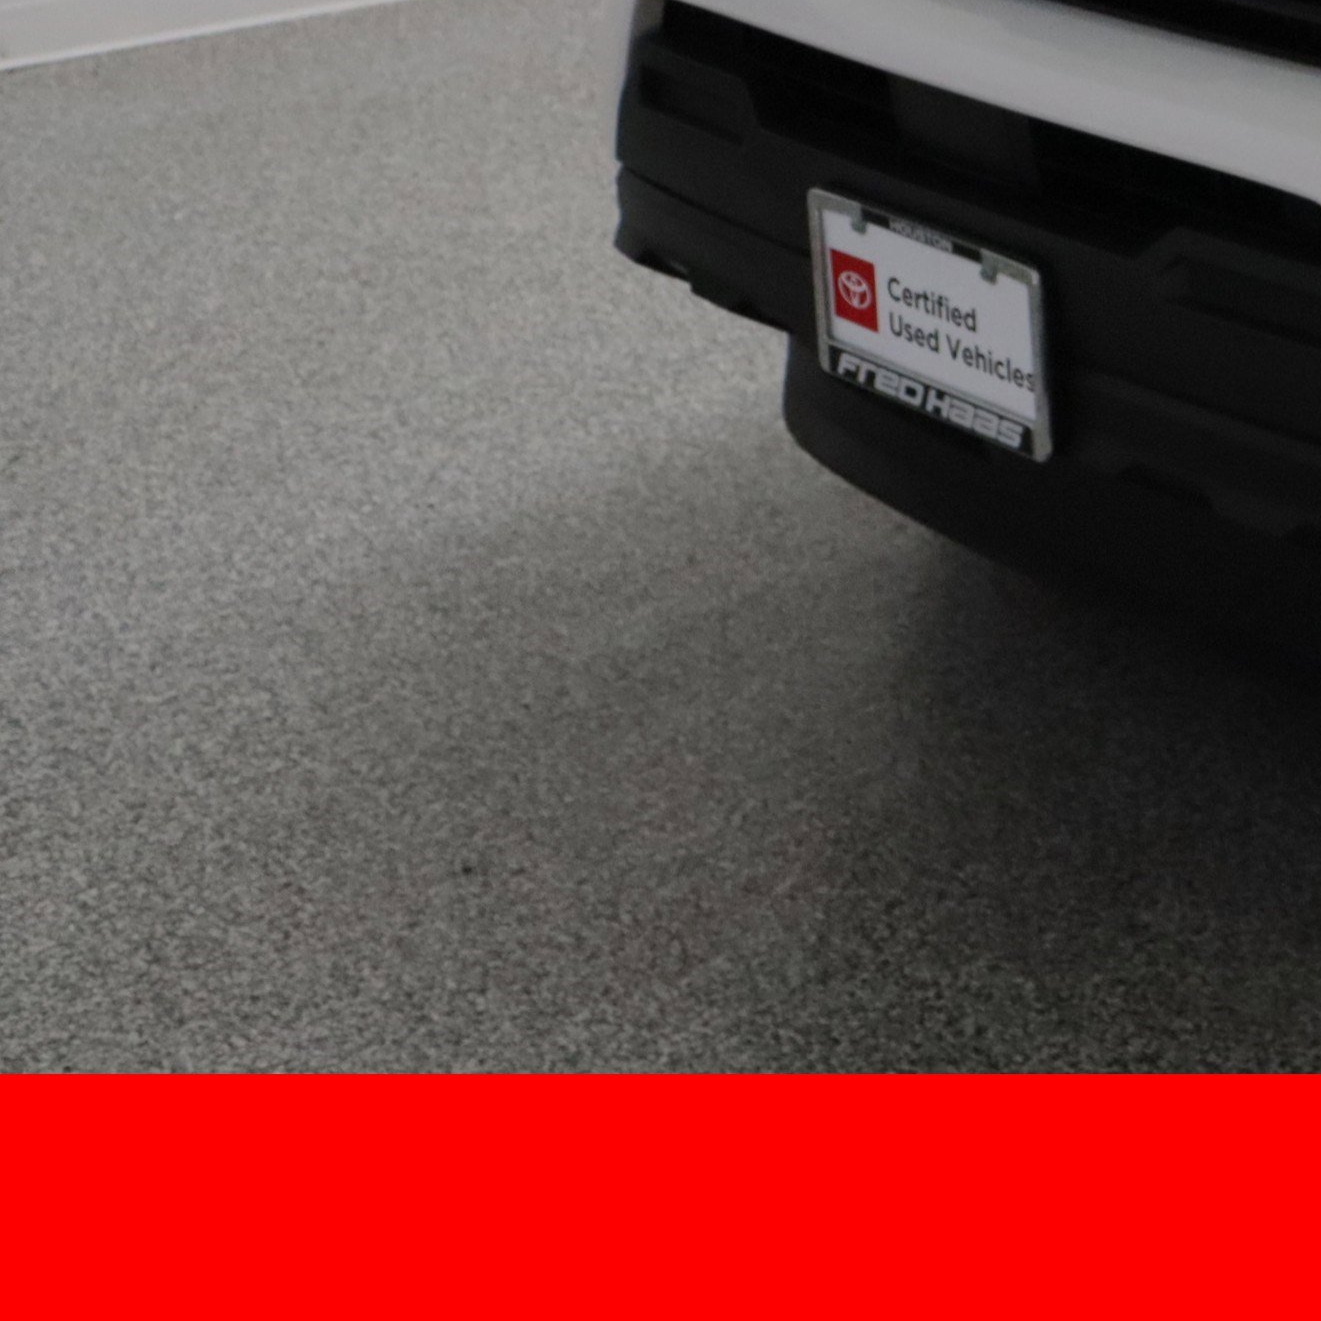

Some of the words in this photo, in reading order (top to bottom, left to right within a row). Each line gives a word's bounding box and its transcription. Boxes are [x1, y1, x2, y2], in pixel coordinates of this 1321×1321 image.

[887, 277, 977, 332] Certified
[889, 312, 939, 353] Used
[946, 334, 1036, 392] Vehicles
